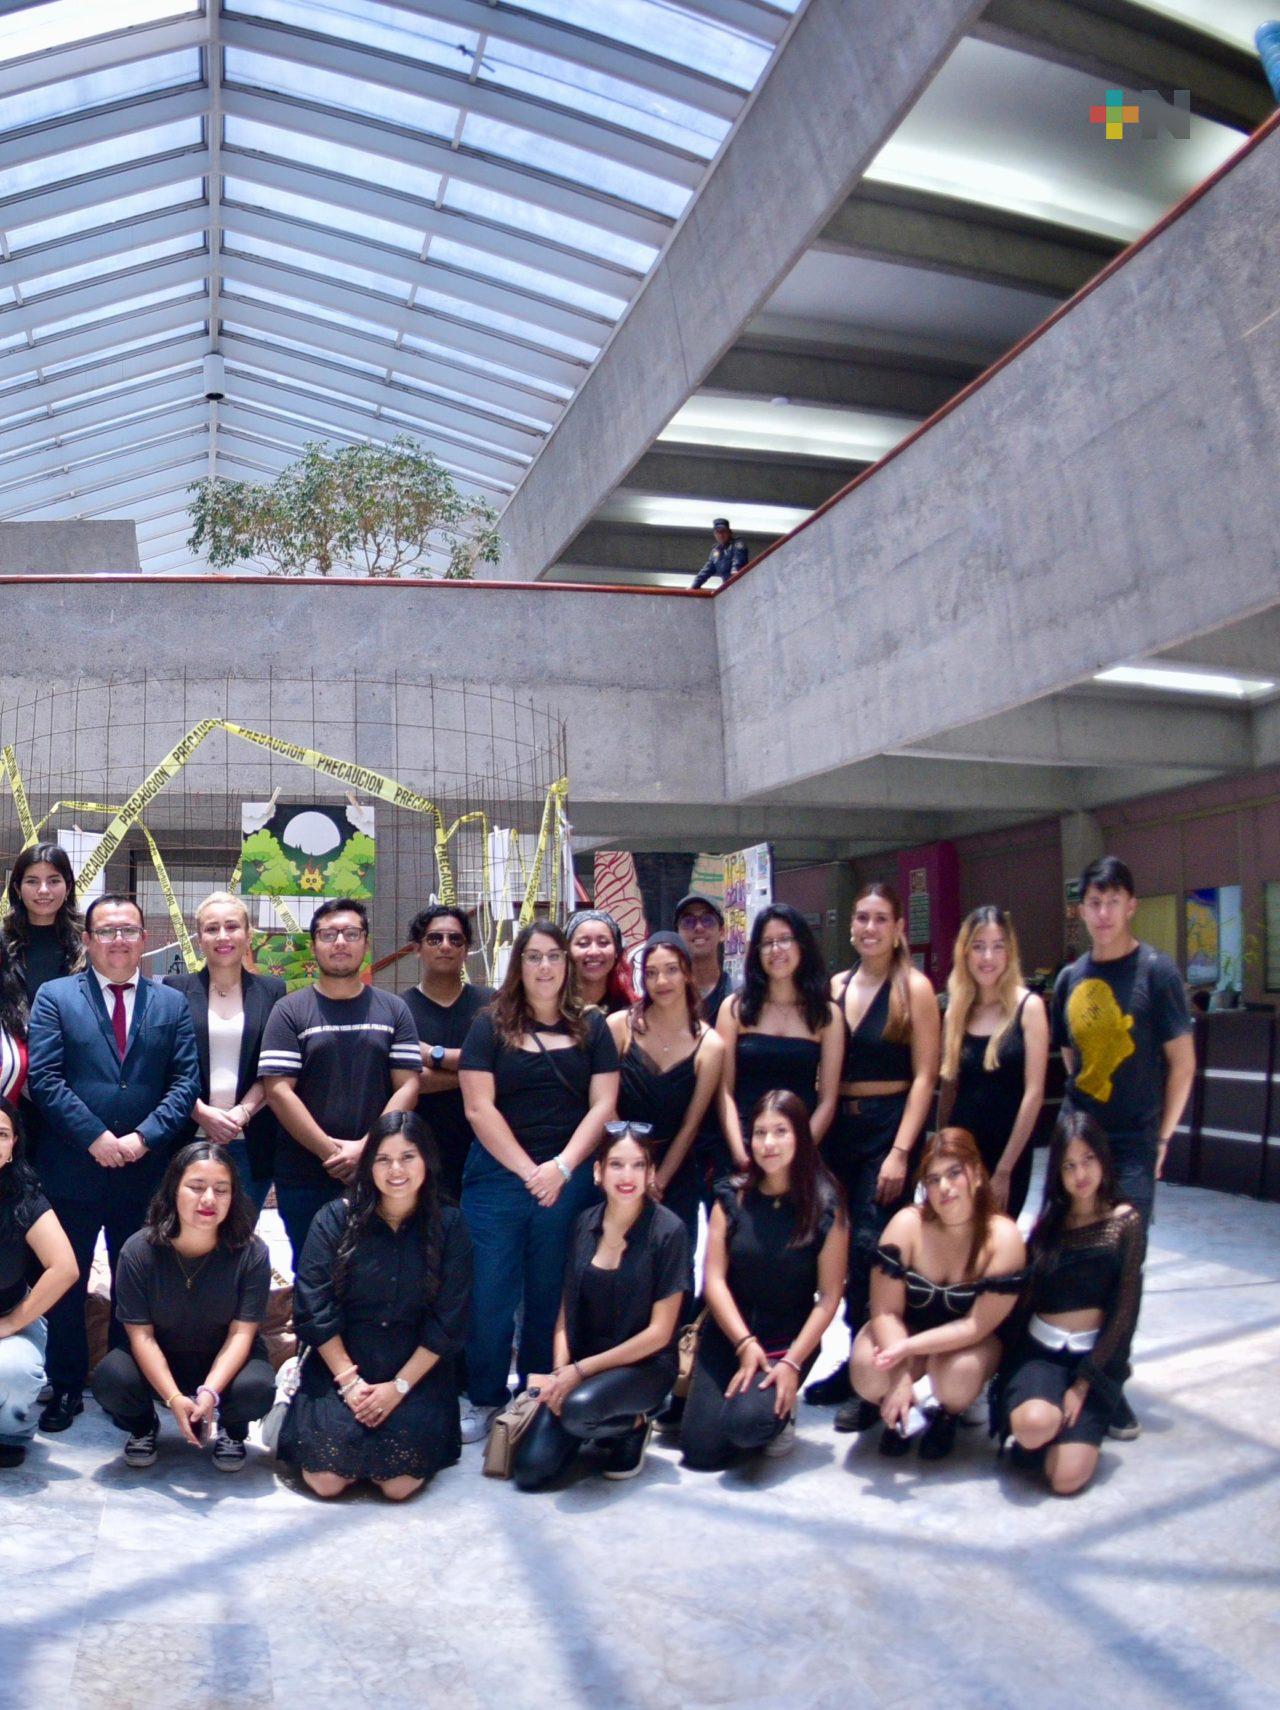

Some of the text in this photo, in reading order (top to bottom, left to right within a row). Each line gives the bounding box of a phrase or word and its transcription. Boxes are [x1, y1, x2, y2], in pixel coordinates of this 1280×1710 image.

[75, 831, 119, 893] PRECAUCION
[119, 766, 171, 827] PRECAUCION
[437, 843, 457, 907] PRECAUCIO
